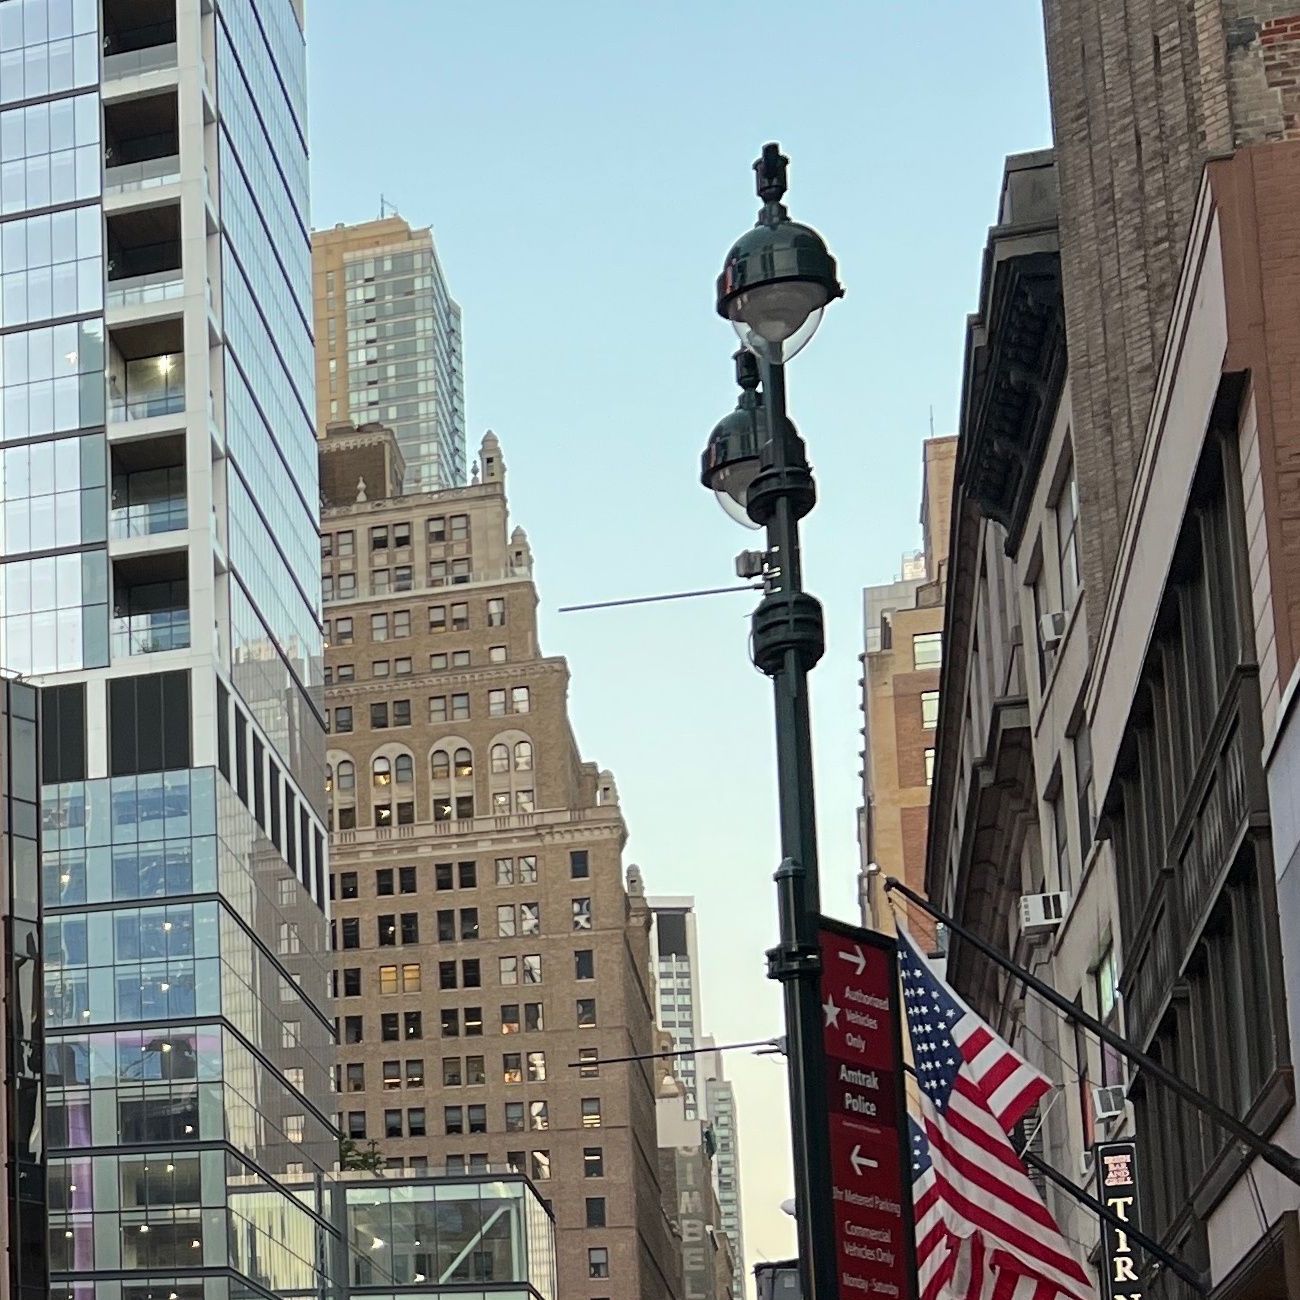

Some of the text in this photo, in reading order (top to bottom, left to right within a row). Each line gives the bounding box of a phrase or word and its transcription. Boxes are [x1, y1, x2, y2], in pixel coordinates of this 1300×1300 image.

[846, 1009, 878, 1030] Vehicles
[845, 1032, 867, 1053] Only
[839, 1063, 879, 1090] Amtrak
[844, 1092, 877, 1116] Police
